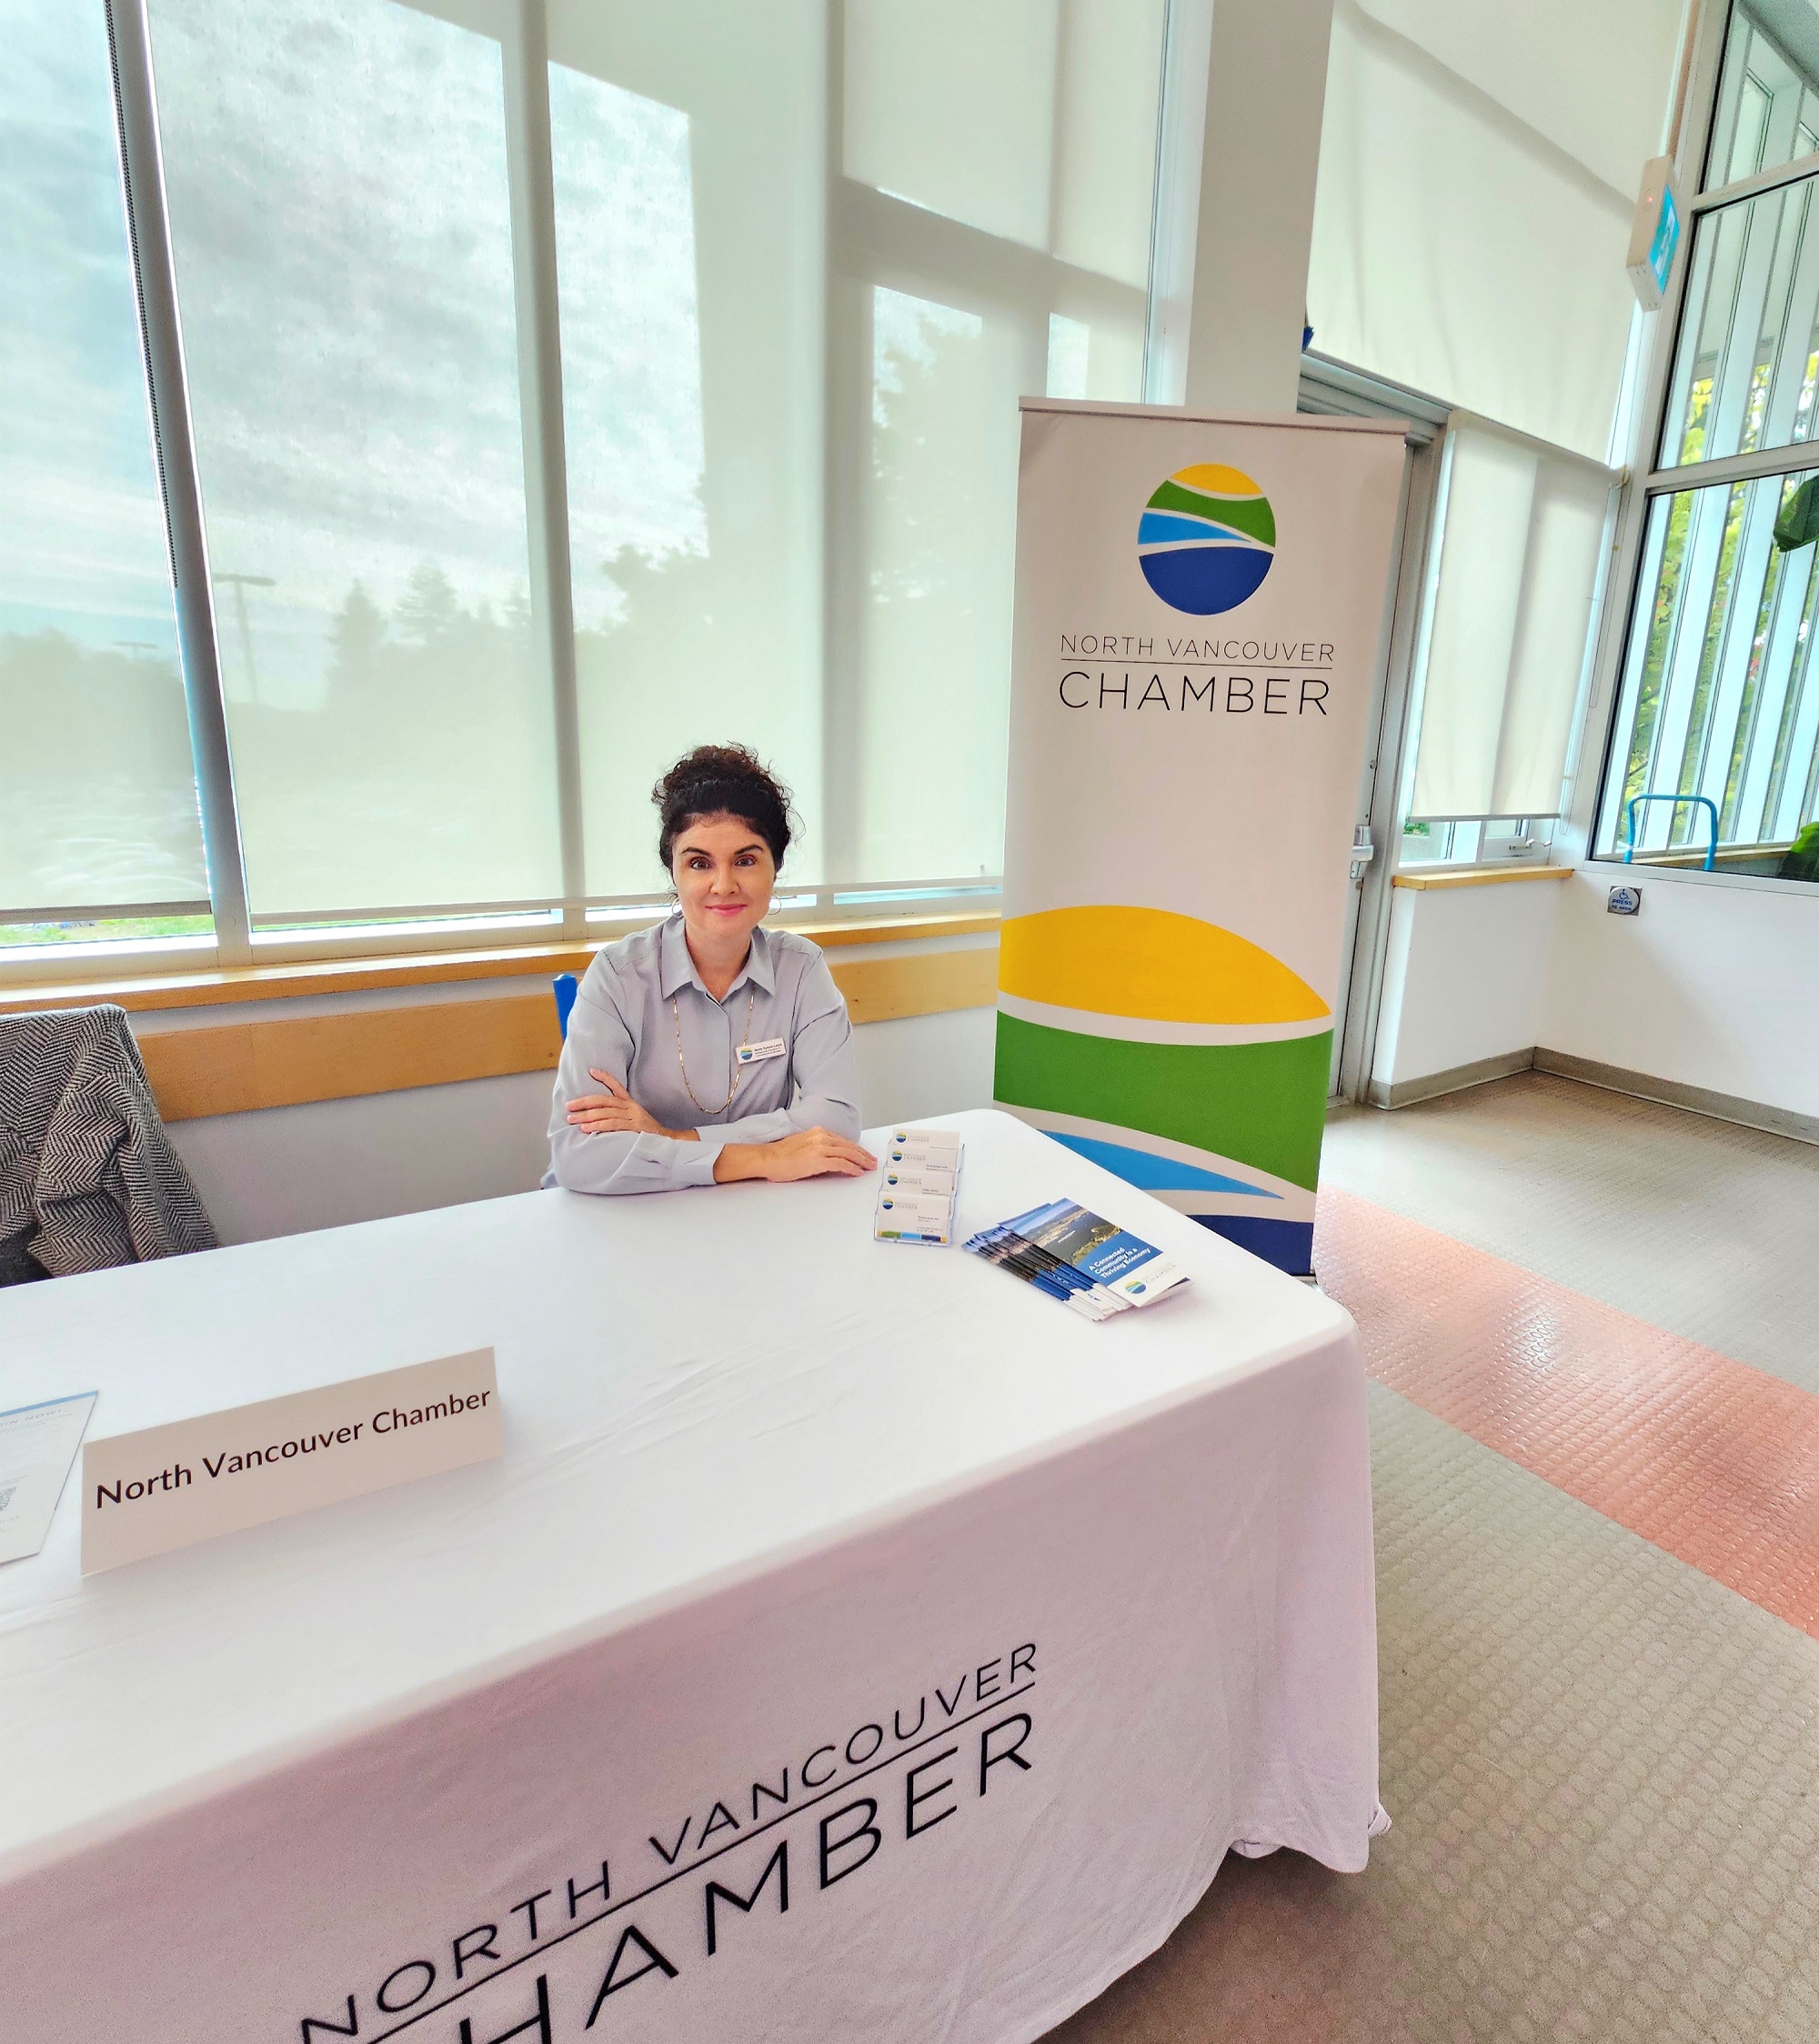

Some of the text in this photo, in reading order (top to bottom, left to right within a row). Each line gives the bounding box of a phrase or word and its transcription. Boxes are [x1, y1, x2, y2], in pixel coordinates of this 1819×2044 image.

[1060, 634, 1335, 662] NORTH VANCOUVER
[1059, 671, 1330, 716] CHAMBER
[1094, 1247, 1125, 1267] Connected
[1094, 1253, 1128, 1274] Community
[1100, 1261, 1127, 1278] Thriving
[1124, 1247, 1151, 1265] Economy
[95, 1390, 491, 1509] North Vancouver Chamber
[301, 1642, 1038, 2044] NORTH VANCOUVER
